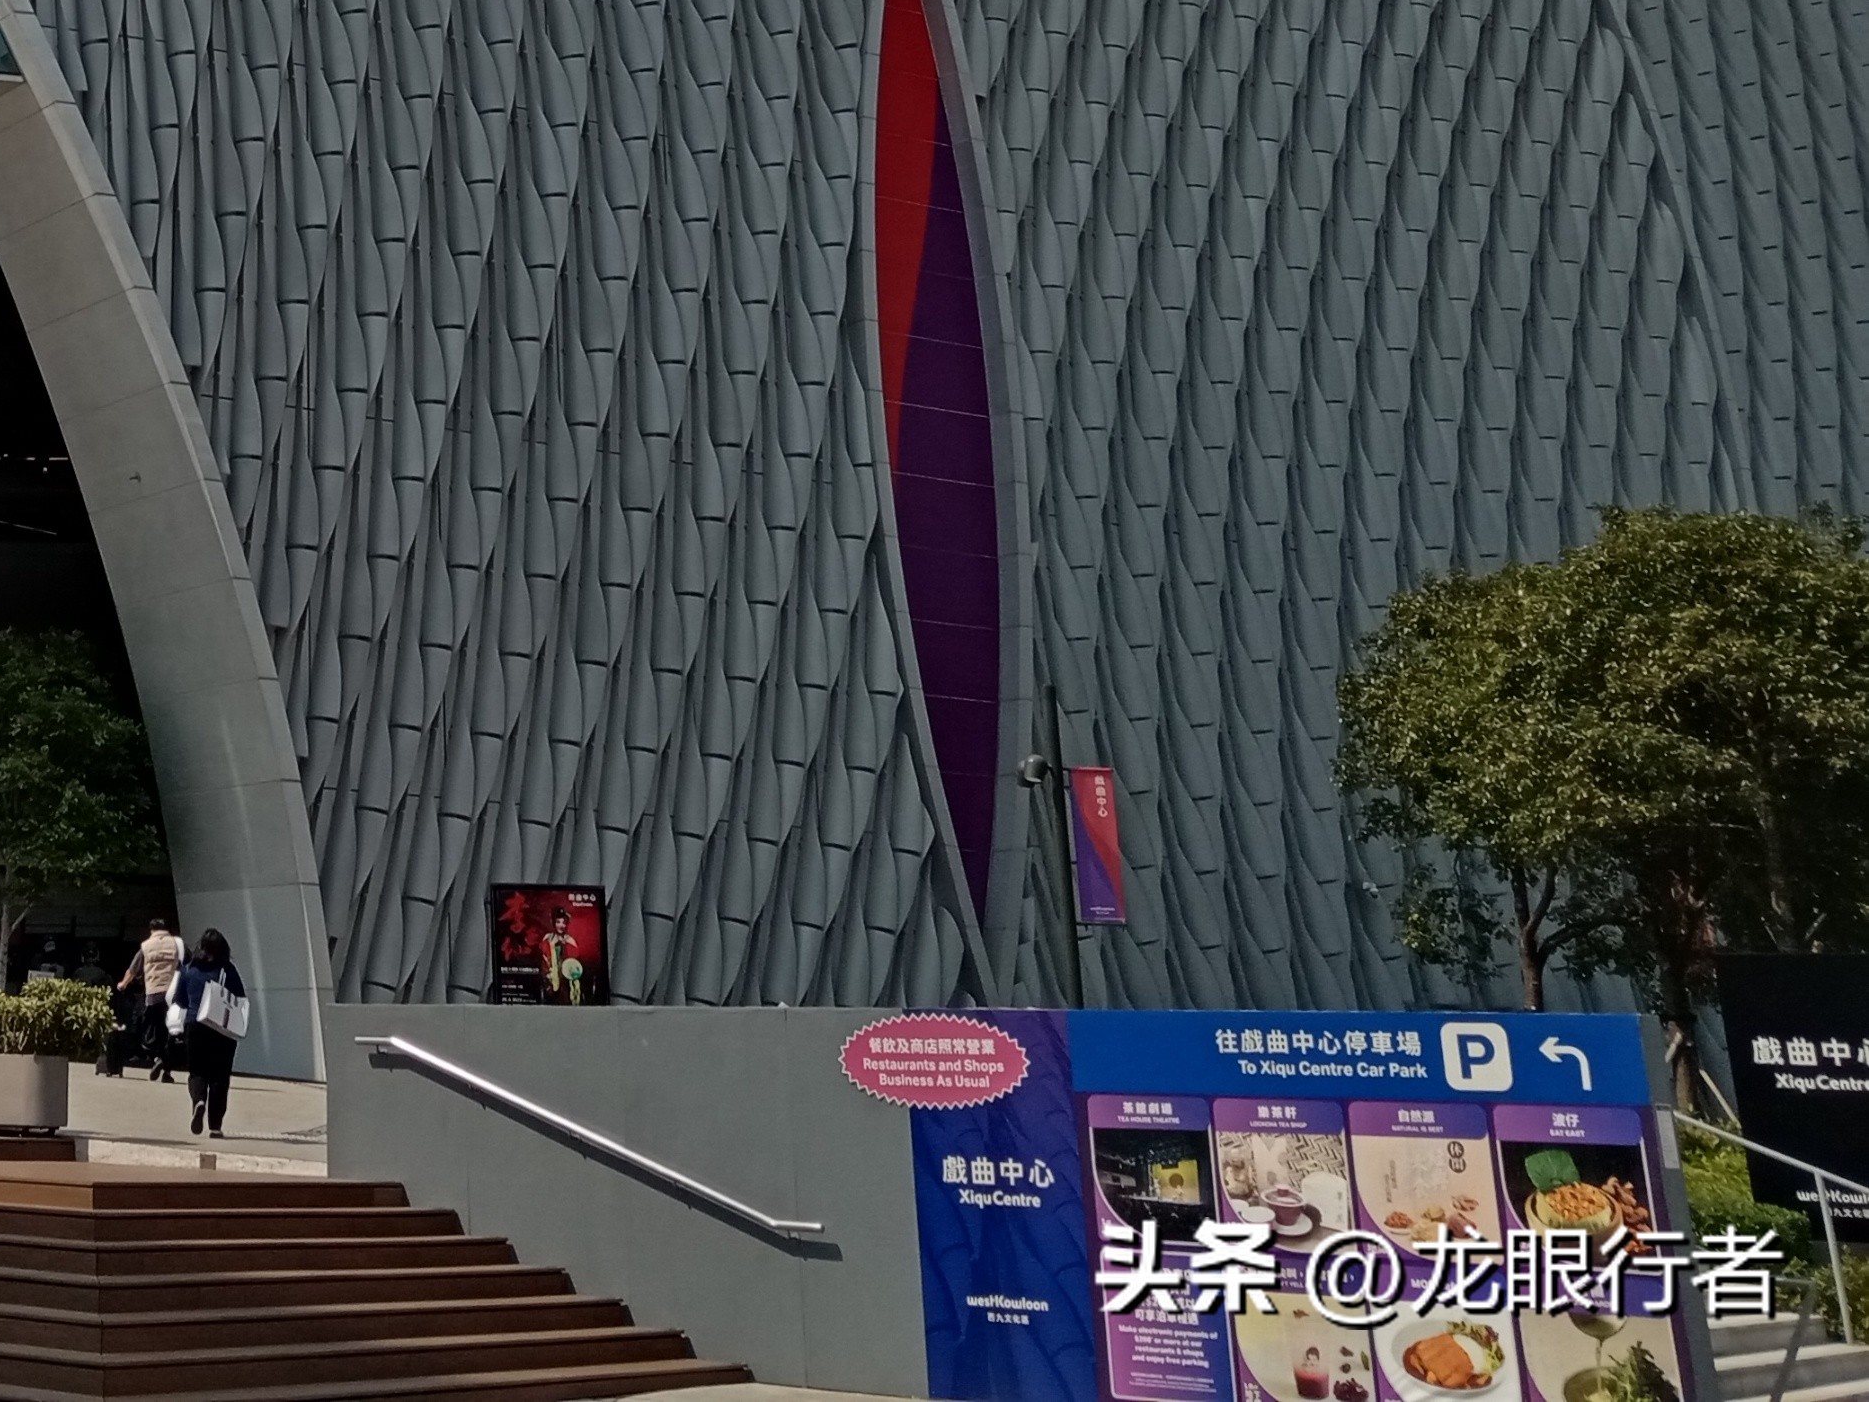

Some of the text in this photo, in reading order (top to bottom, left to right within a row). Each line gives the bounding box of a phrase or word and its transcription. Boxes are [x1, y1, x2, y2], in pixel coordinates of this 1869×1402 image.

[868, 1037, 996, 1056] 餐飲及商店照常營業
[1215, 1028, 1422, 1058] 往戲曲中心停車場
[863, 1057, 1005, 1074] Restaurants and Shops
[1238, 1059, 1428, 1079] To Xiqu Centre Car Park
[878, 1074, 990, 1088] Business As Usual
[942, 1155, 1055, 1189] 戲曲中心
